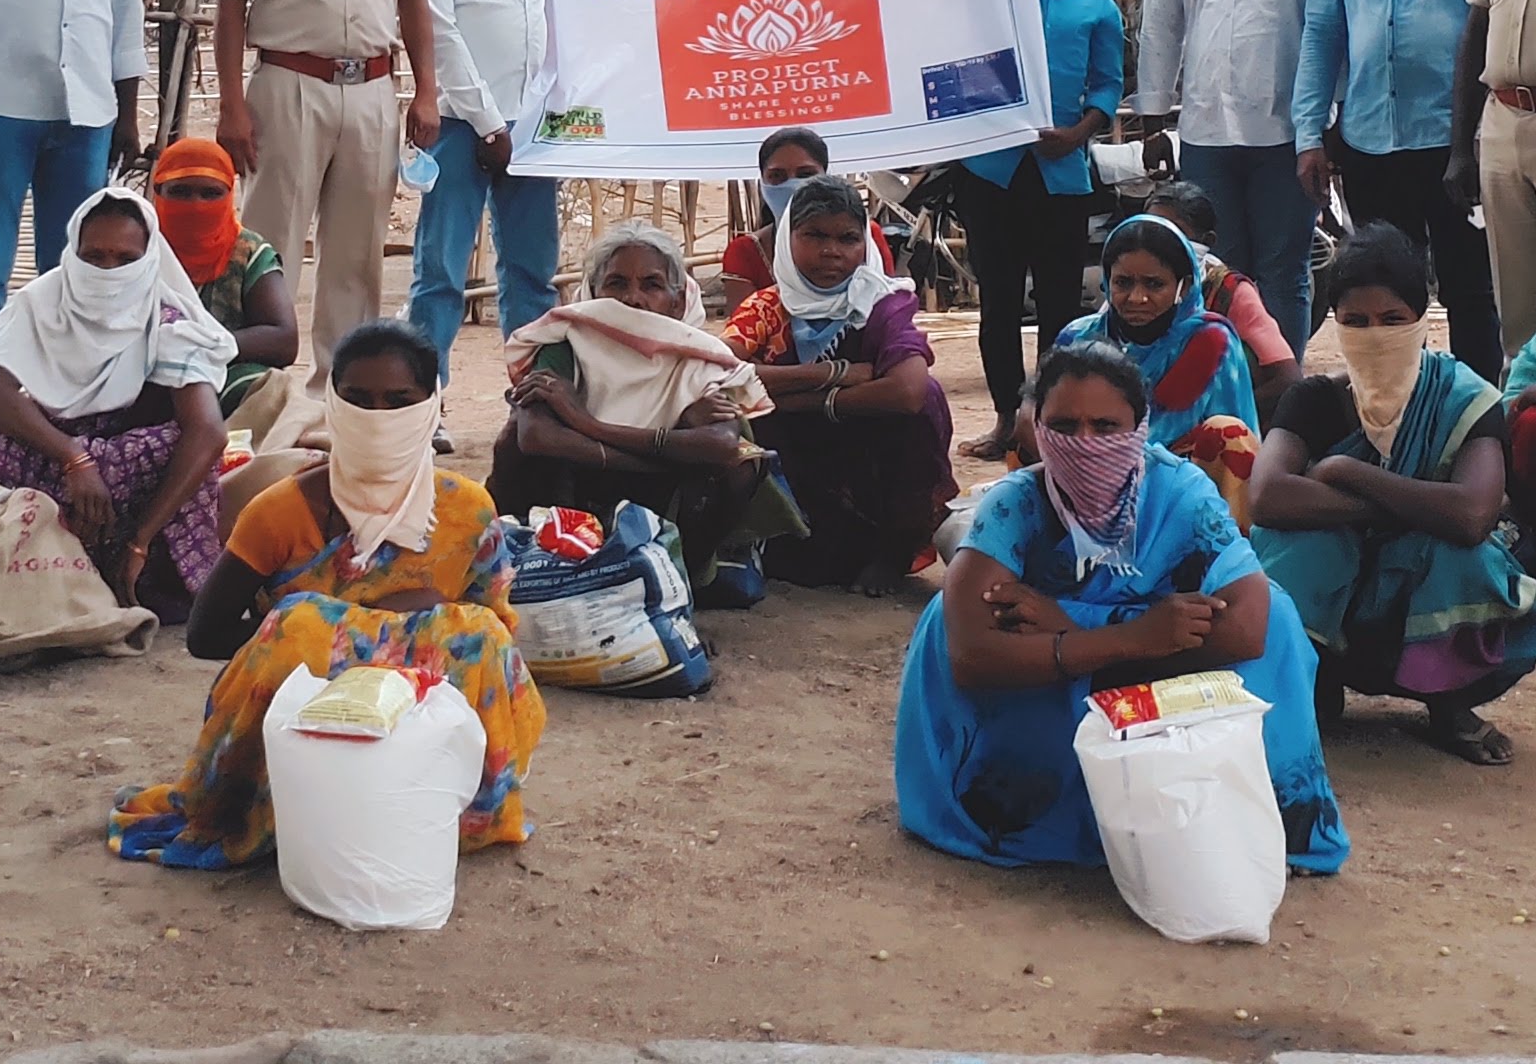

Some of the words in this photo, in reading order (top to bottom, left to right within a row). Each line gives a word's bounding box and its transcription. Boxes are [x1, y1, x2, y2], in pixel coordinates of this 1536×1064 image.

[713, 59, 840, 84] PROJECT
[685, 71, 873, 100] ANNAPURNA
[720, 99, 780, 111] SHARE
[791, 92, 841, 105] YOUR
[729, 104, 835, 121] BLESSINGS
